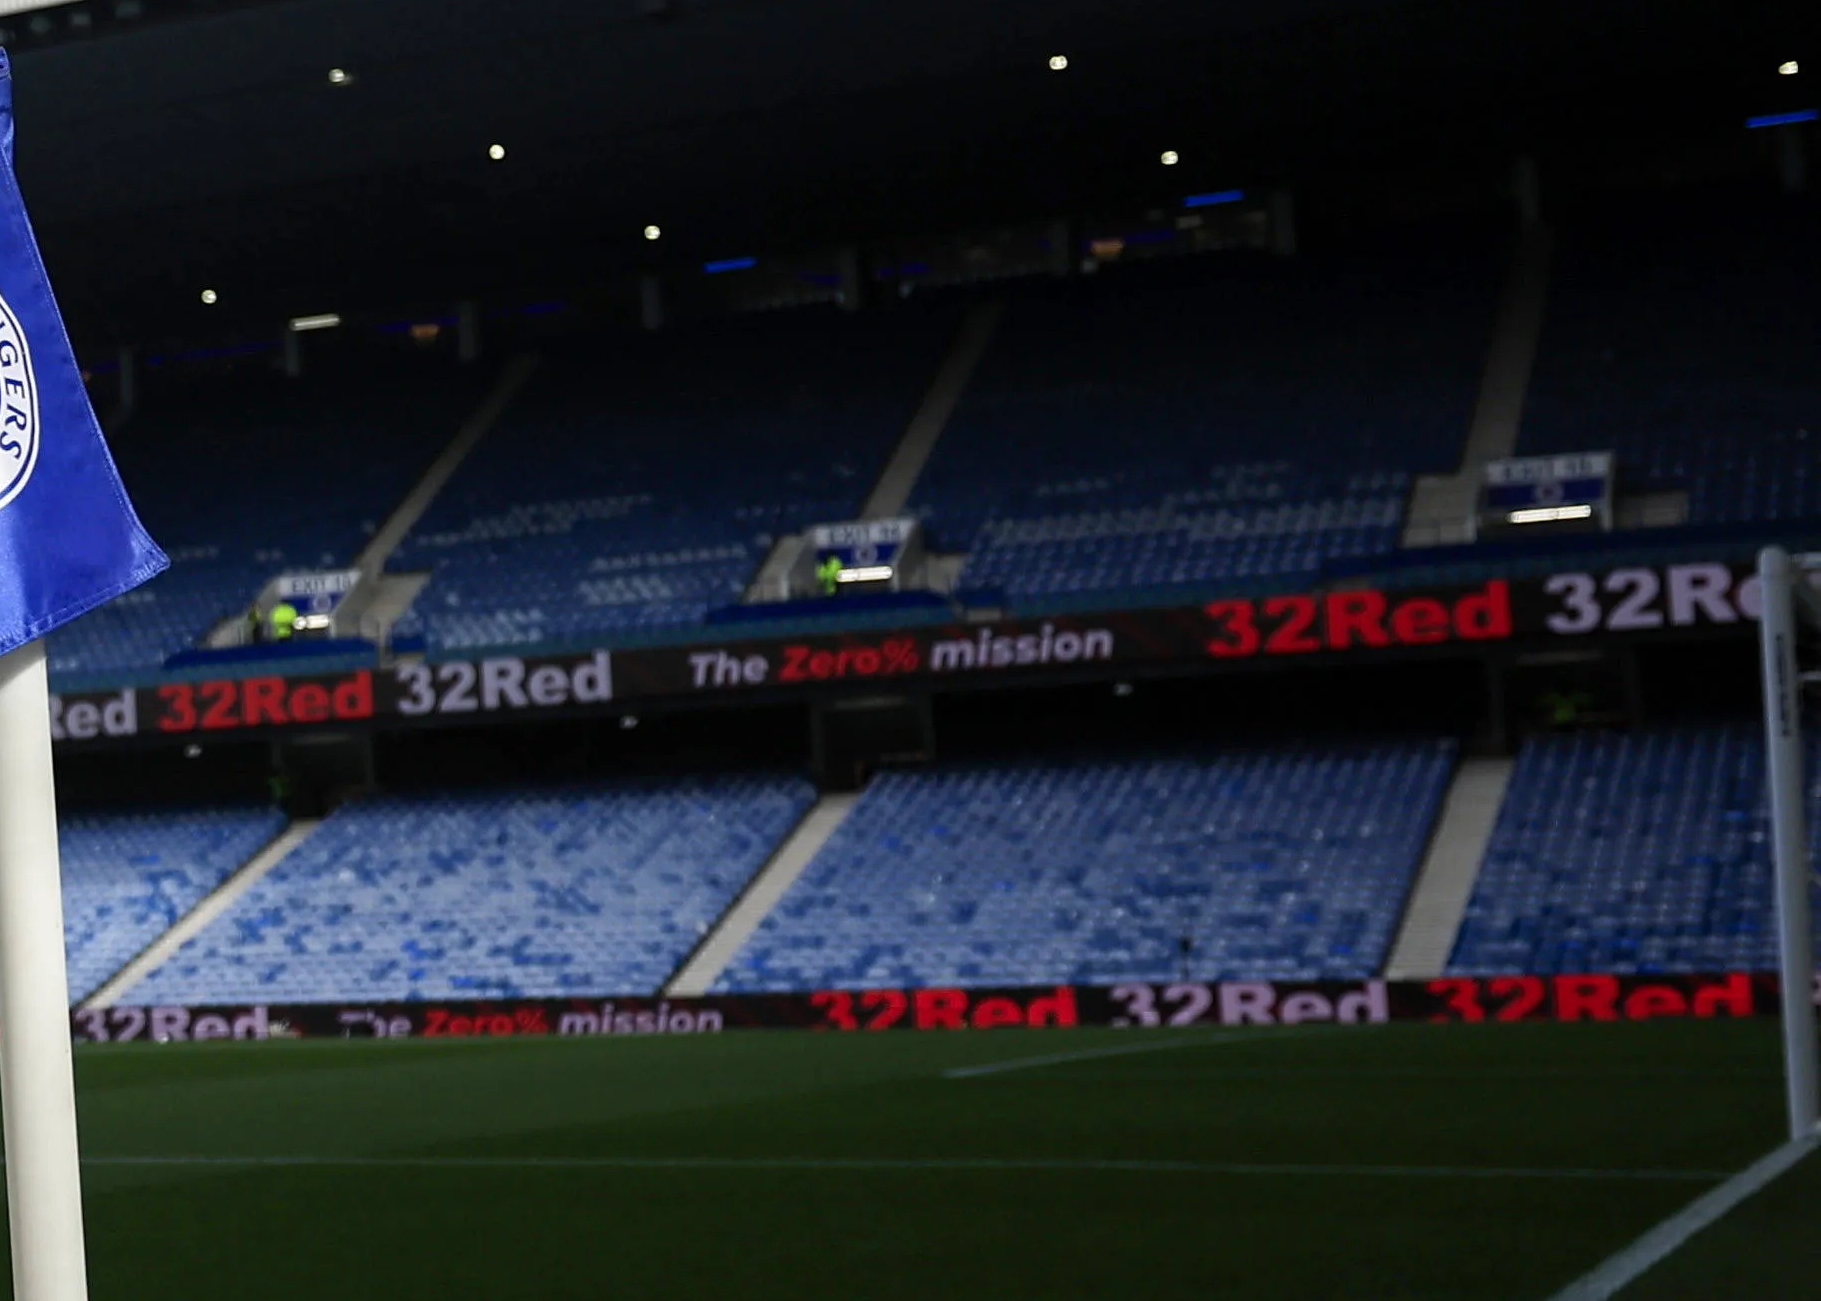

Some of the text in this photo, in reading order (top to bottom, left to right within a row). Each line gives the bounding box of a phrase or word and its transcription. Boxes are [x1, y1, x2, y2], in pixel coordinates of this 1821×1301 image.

[1204, 579, 1513, 657] 32Red
[1545, 562, 1765, 635] 32R
[396, 651, 613, 716] 32Red
[689, 626, 1113, 688] The Zero% mission
[158, 672, 373, 731] 32Red
[560, 1002, 722, 1035] mission
[810, 987, 1076, 1031] 32Red
[1110, 980, 1389, 1027] 32Red
[1426, 972, 1754, 1022] 32Red
